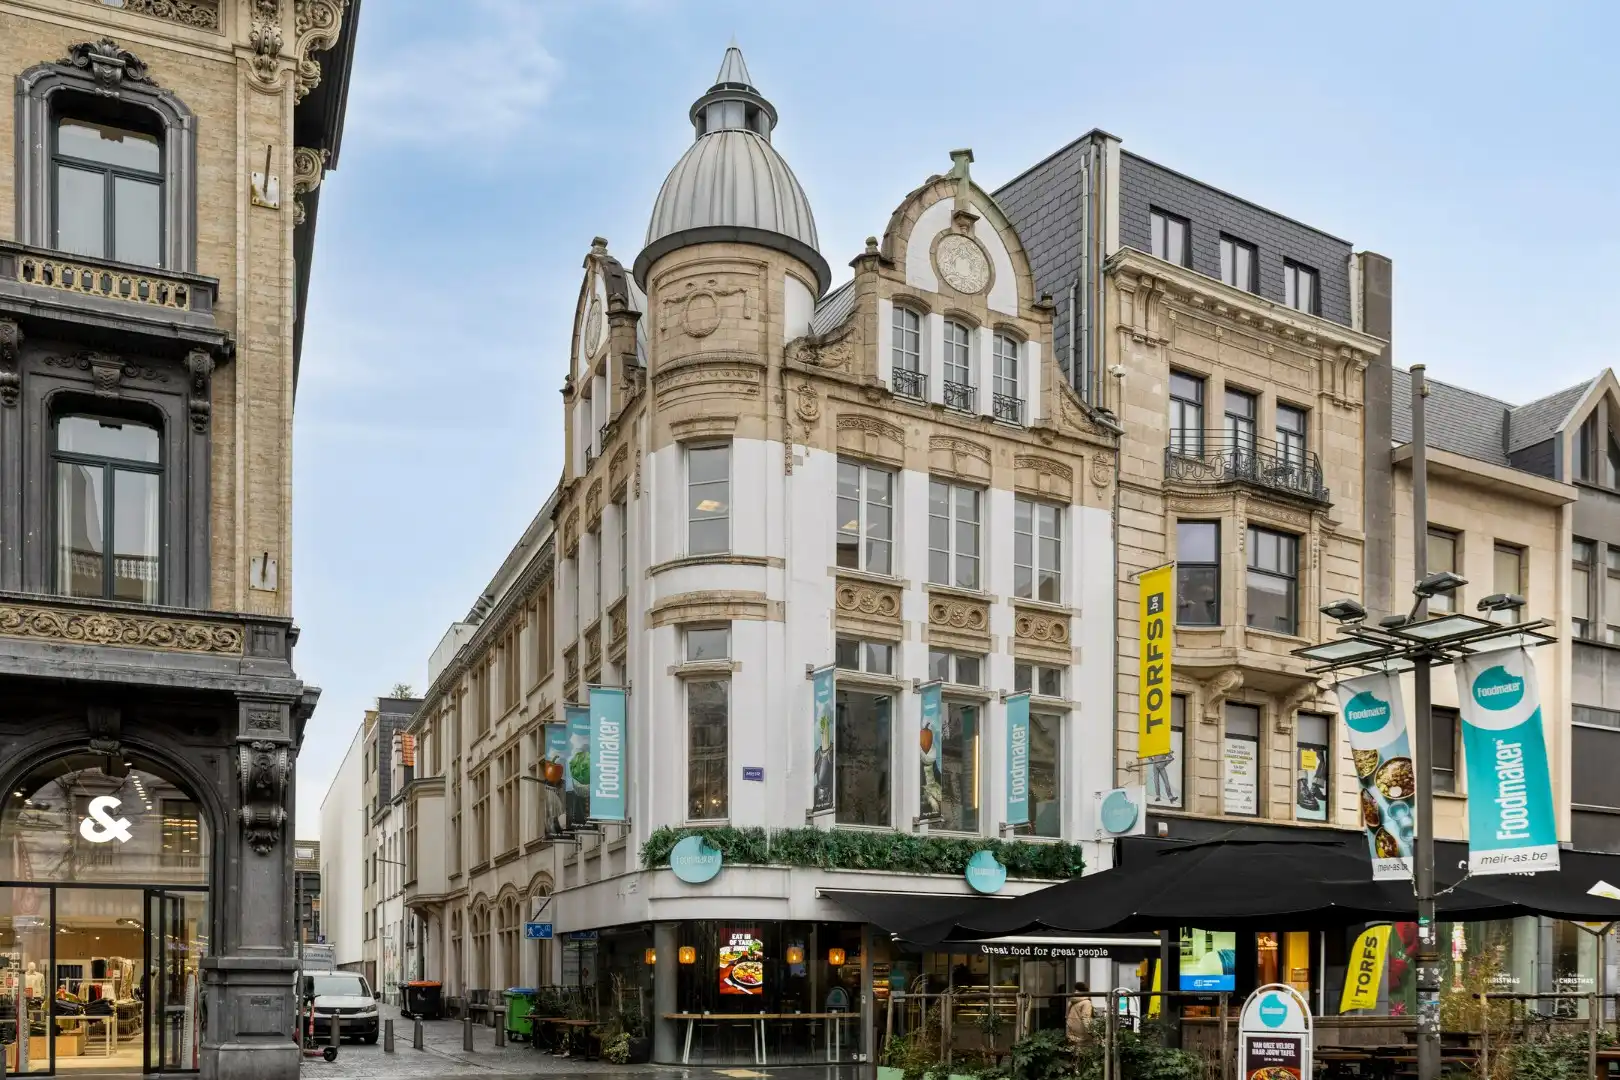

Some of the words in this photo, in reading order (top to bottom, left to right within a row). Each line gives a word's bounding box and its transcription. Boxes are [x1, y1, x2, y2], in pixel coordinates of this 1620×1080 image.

[1146, 617, 1164, 735] TORFS
[1477, 682, 1521, 698] Foodmaker
[1348, 706, 1387, 720] Foodmaker
[596, 716, 620, 799] Foodmaker
[1009, 723, 1026, 804] Foodmaker
[1494, 739, 1531, 841] Foodmaker
[1480, 851, 1548, 865] meir-as.be
[981, 945, 1009, 955] Great
[1010, 946, 1031, 956] food
[1033, 946, 1049, 956] for
[1051, 948, 1076, 958] great
[1077, 947, 1109, 958] people
[1355, 936, 1378, 997] TORFS
[1558, 977, 1595, 985] CHRISTMAS
[1252, 1041, 1263, 1049] VAN
